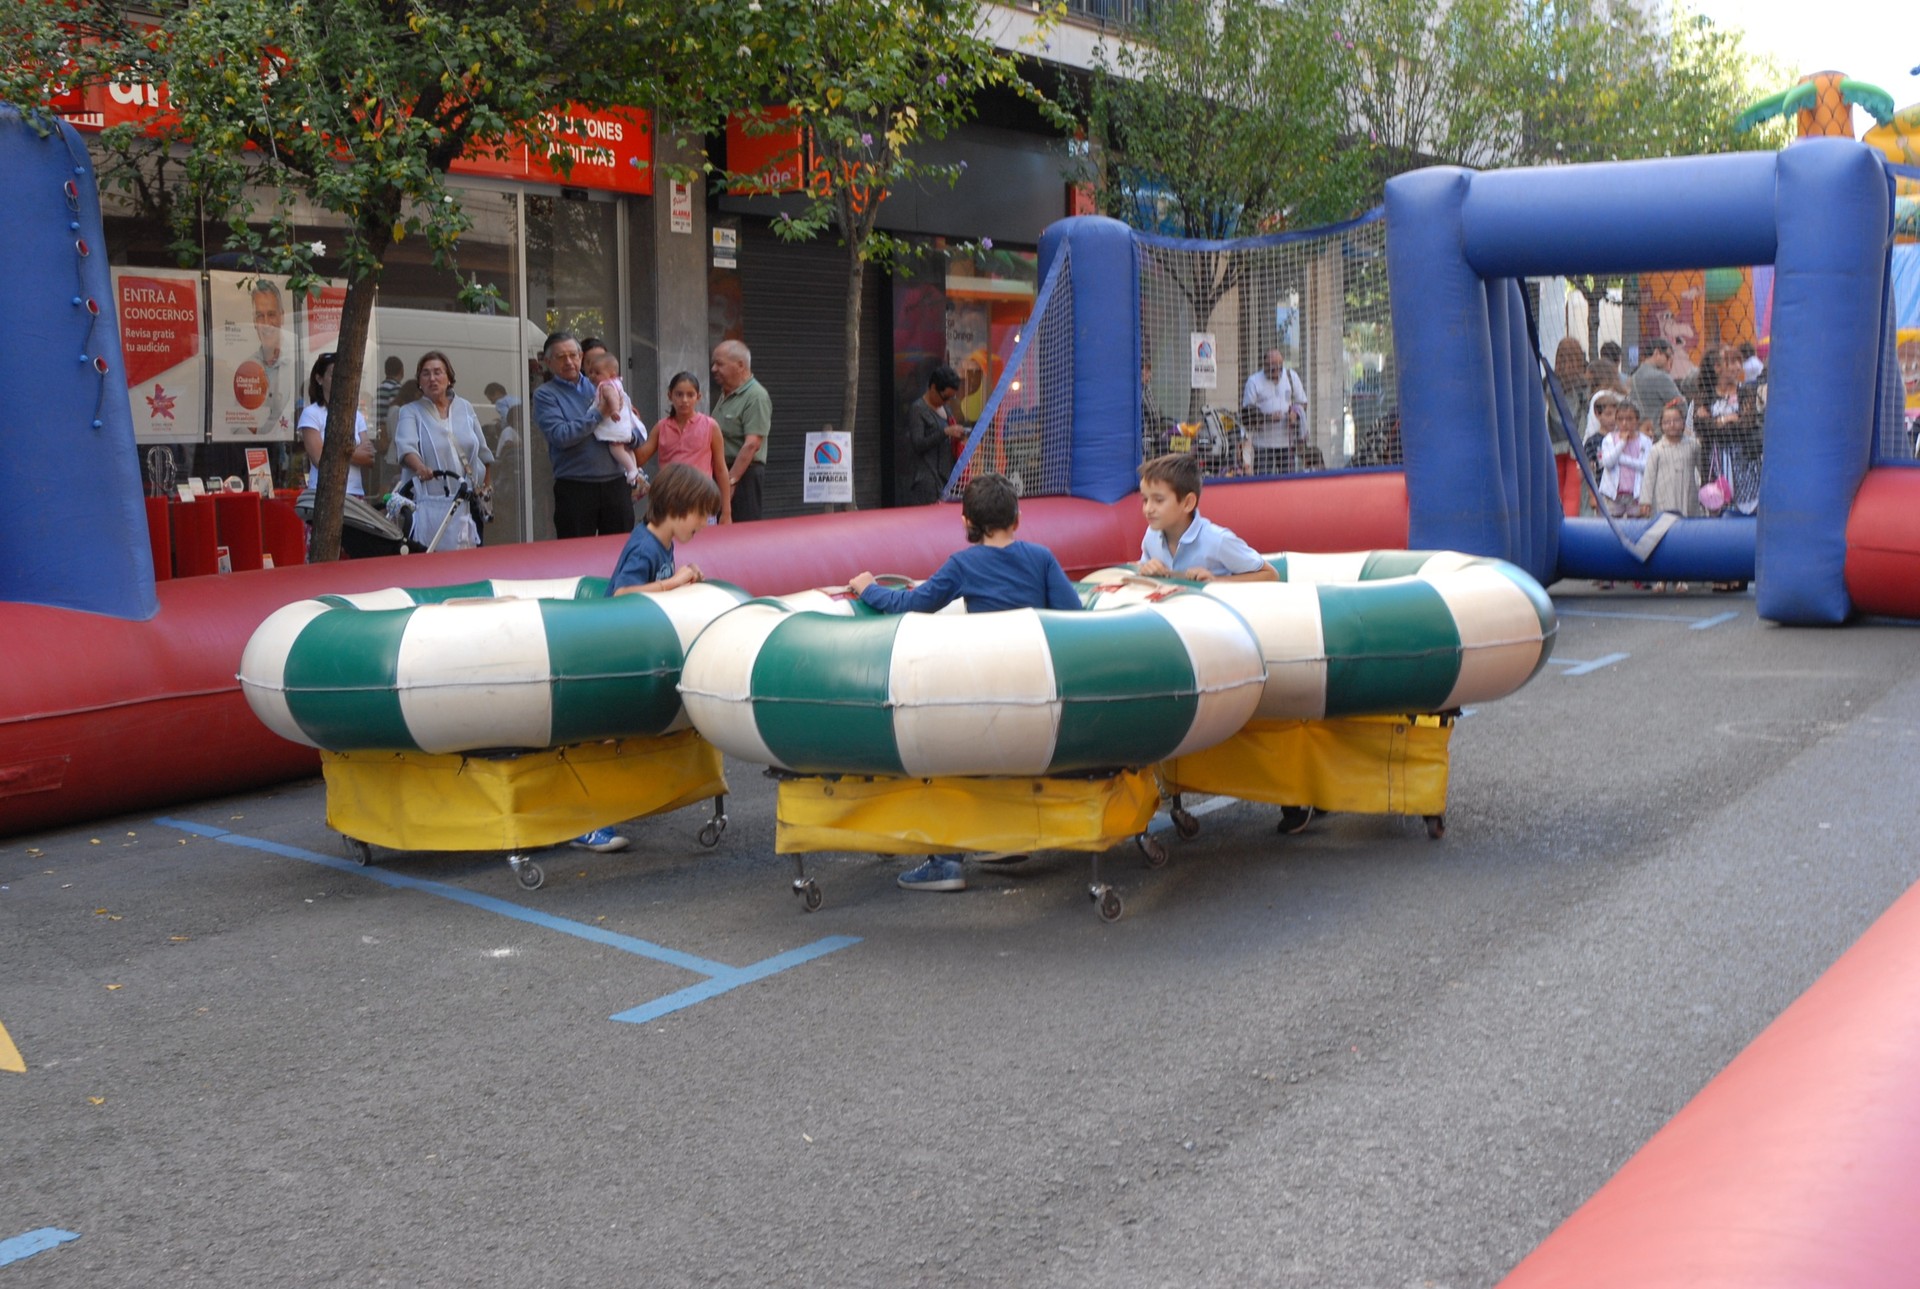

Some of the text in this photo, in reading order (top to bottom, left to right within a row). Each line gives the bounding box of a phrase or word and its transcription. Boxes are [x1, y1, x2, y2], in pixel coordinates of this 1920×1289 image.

[124, 288, 177, 304] ENTRA A
[124, 307, 195, 322] CONOCERNOS
[125, 328, 175, 341] Revisa gratis
[126, 342, 170, 353] tu audición
[808, 475, 848, 483] NO APARCAR
